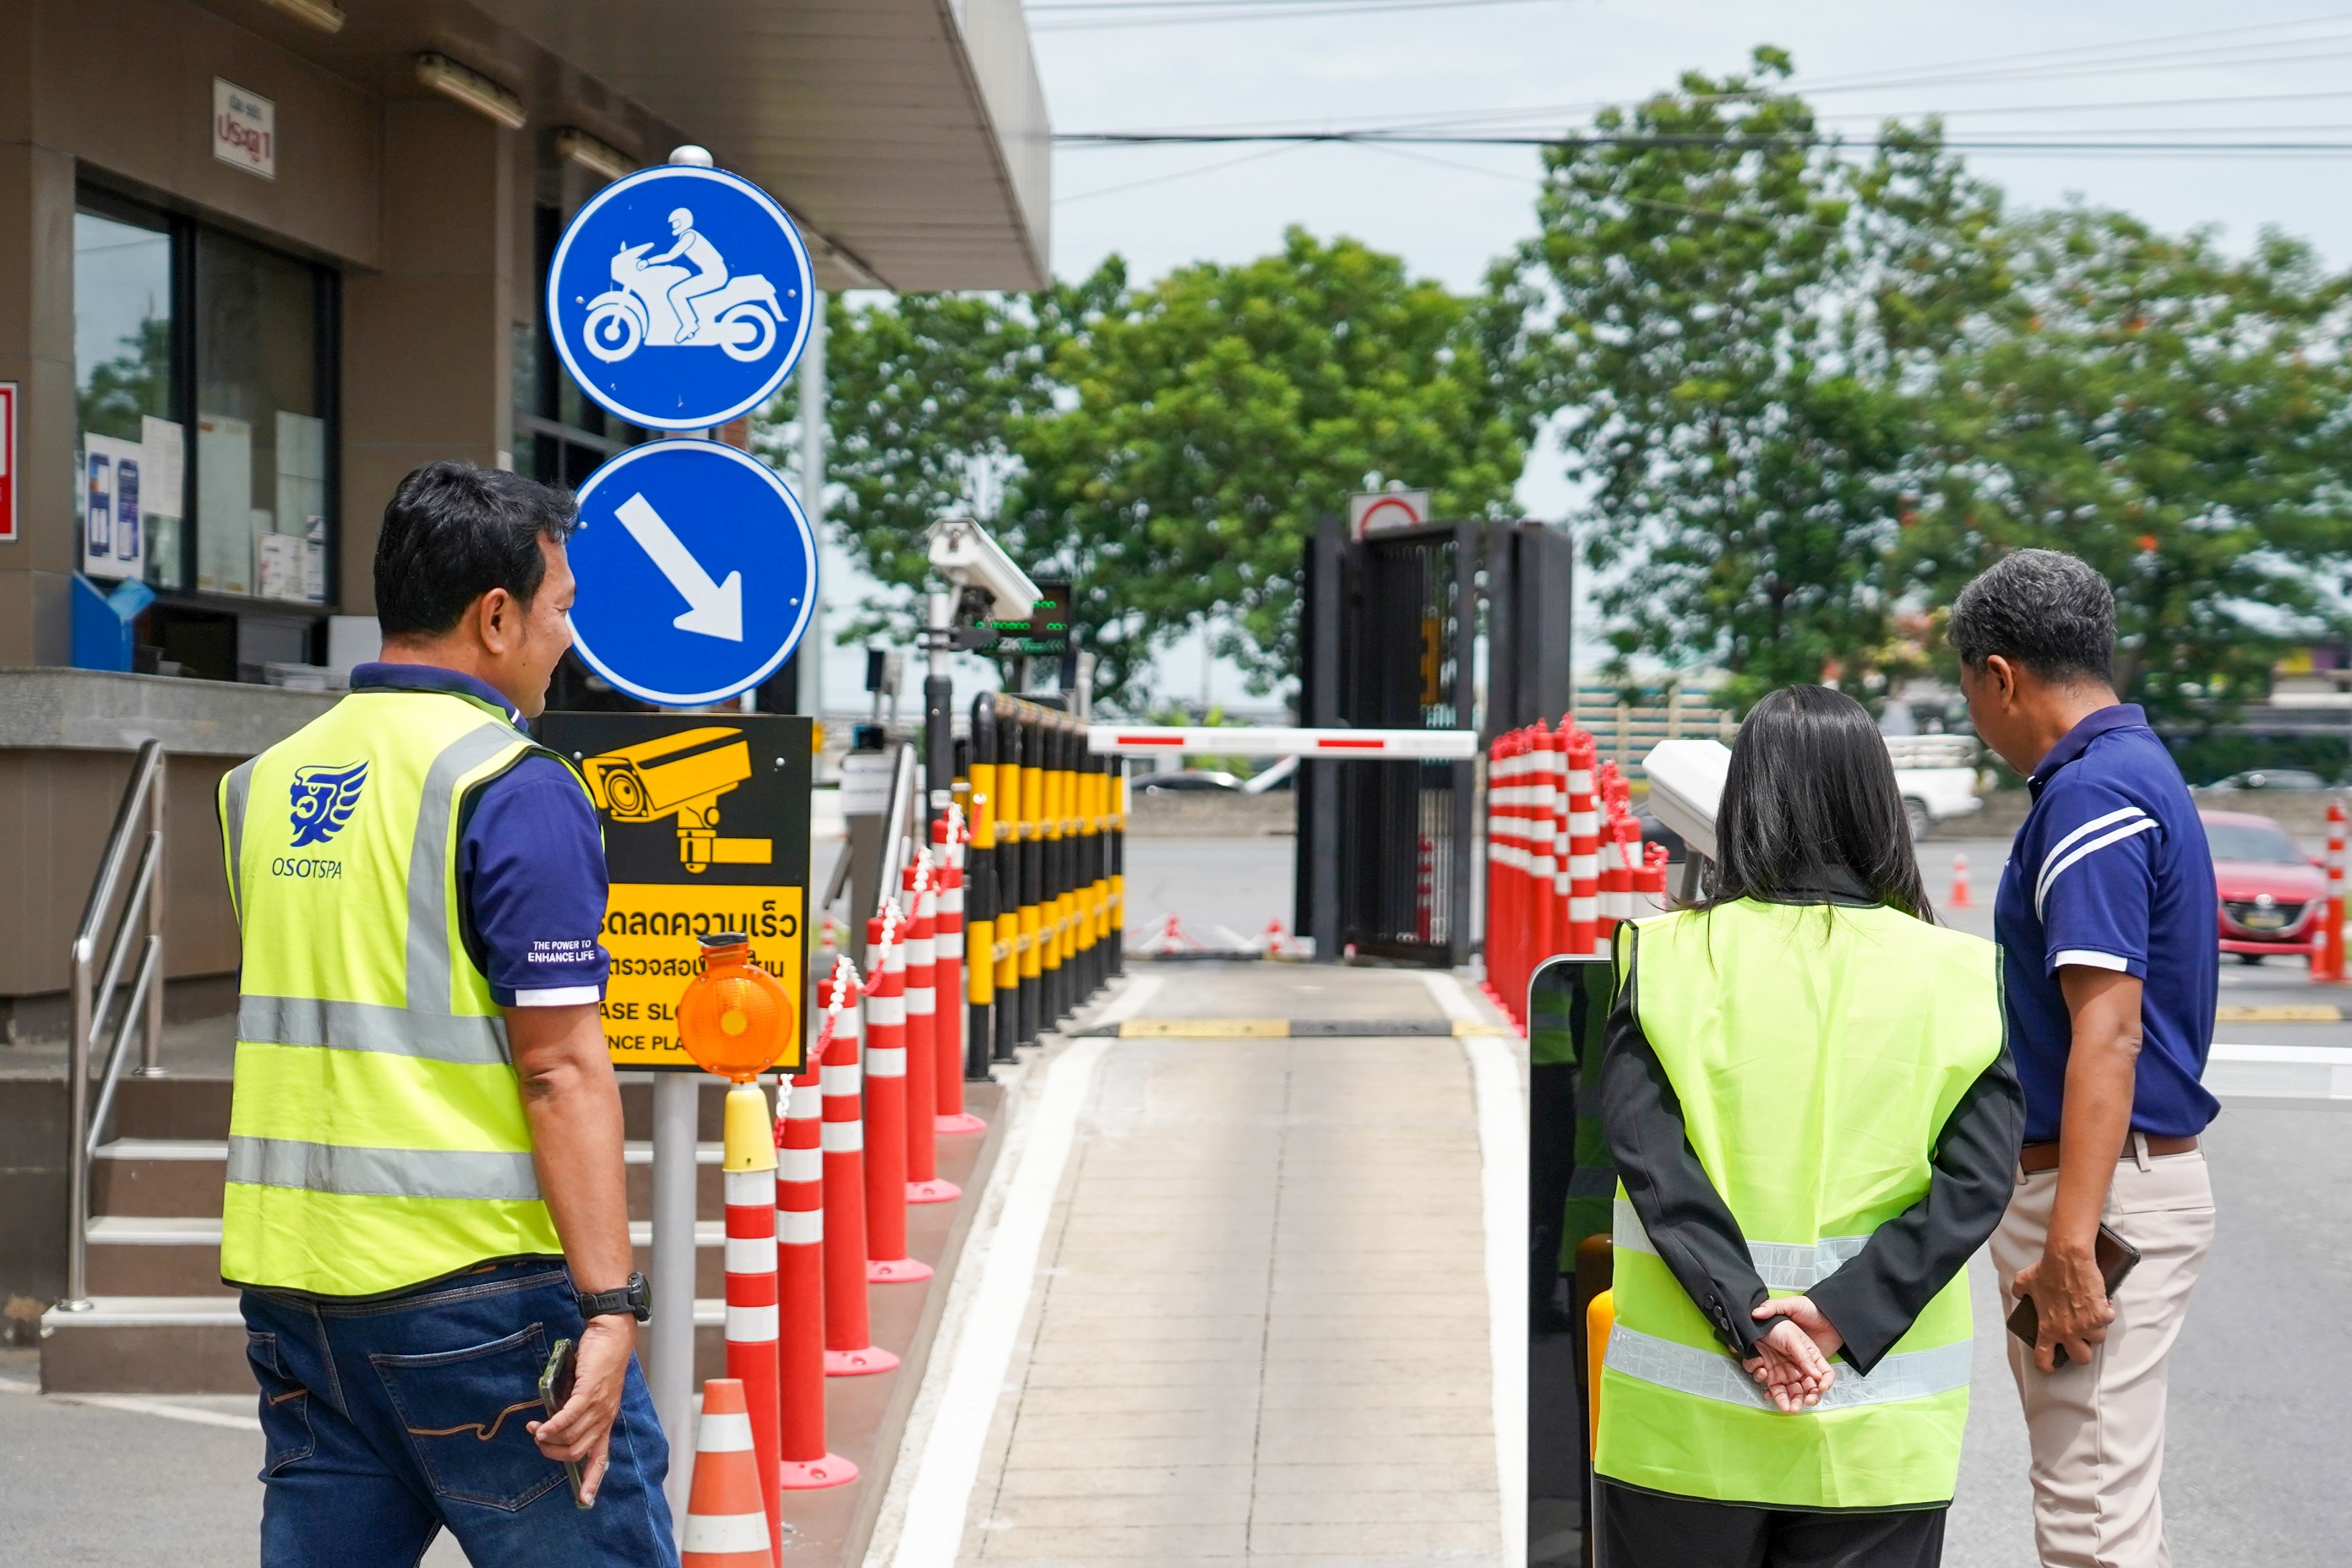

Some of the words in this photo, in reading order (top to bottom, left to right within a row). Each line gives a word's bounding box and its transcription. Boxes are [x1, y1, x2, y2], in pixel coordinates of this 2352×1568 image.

[271, 858, 342, 879] OSOTSPA
[533, 940, 551, 950] THE
[552, 940, 580, 950] POWER
[581, 939, 591, 948] TO
[527, 951, 575, 962] ENHANCE
[575, 950, 595, 961] LIFE
[599, 1002, 640, 1020] ASE
[647, 1003, 679, 1021] SL
[605, 1035, 645, 1050] NCE
[652, 1036, 687, 1051] PLA
